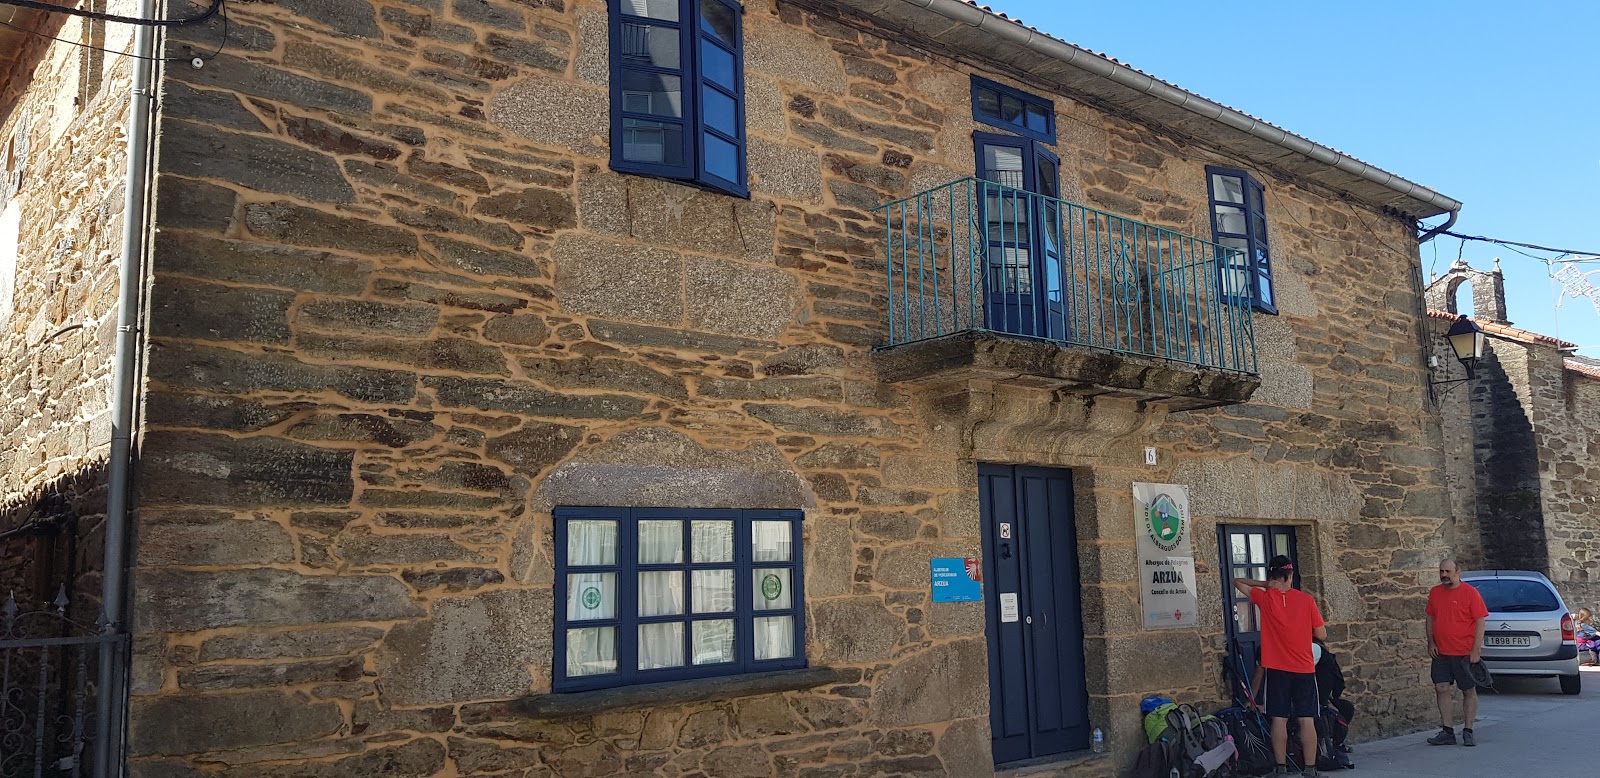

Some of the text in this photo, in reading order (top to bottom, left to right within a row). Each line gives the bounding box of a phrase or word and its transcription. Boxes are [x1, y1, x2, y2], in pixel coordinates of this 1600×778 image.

[1148, 450, 1153, 462] 6
[1153, 567, 1184, 584] ARZÚA
[1491, 637, 1510, 645] 1898
